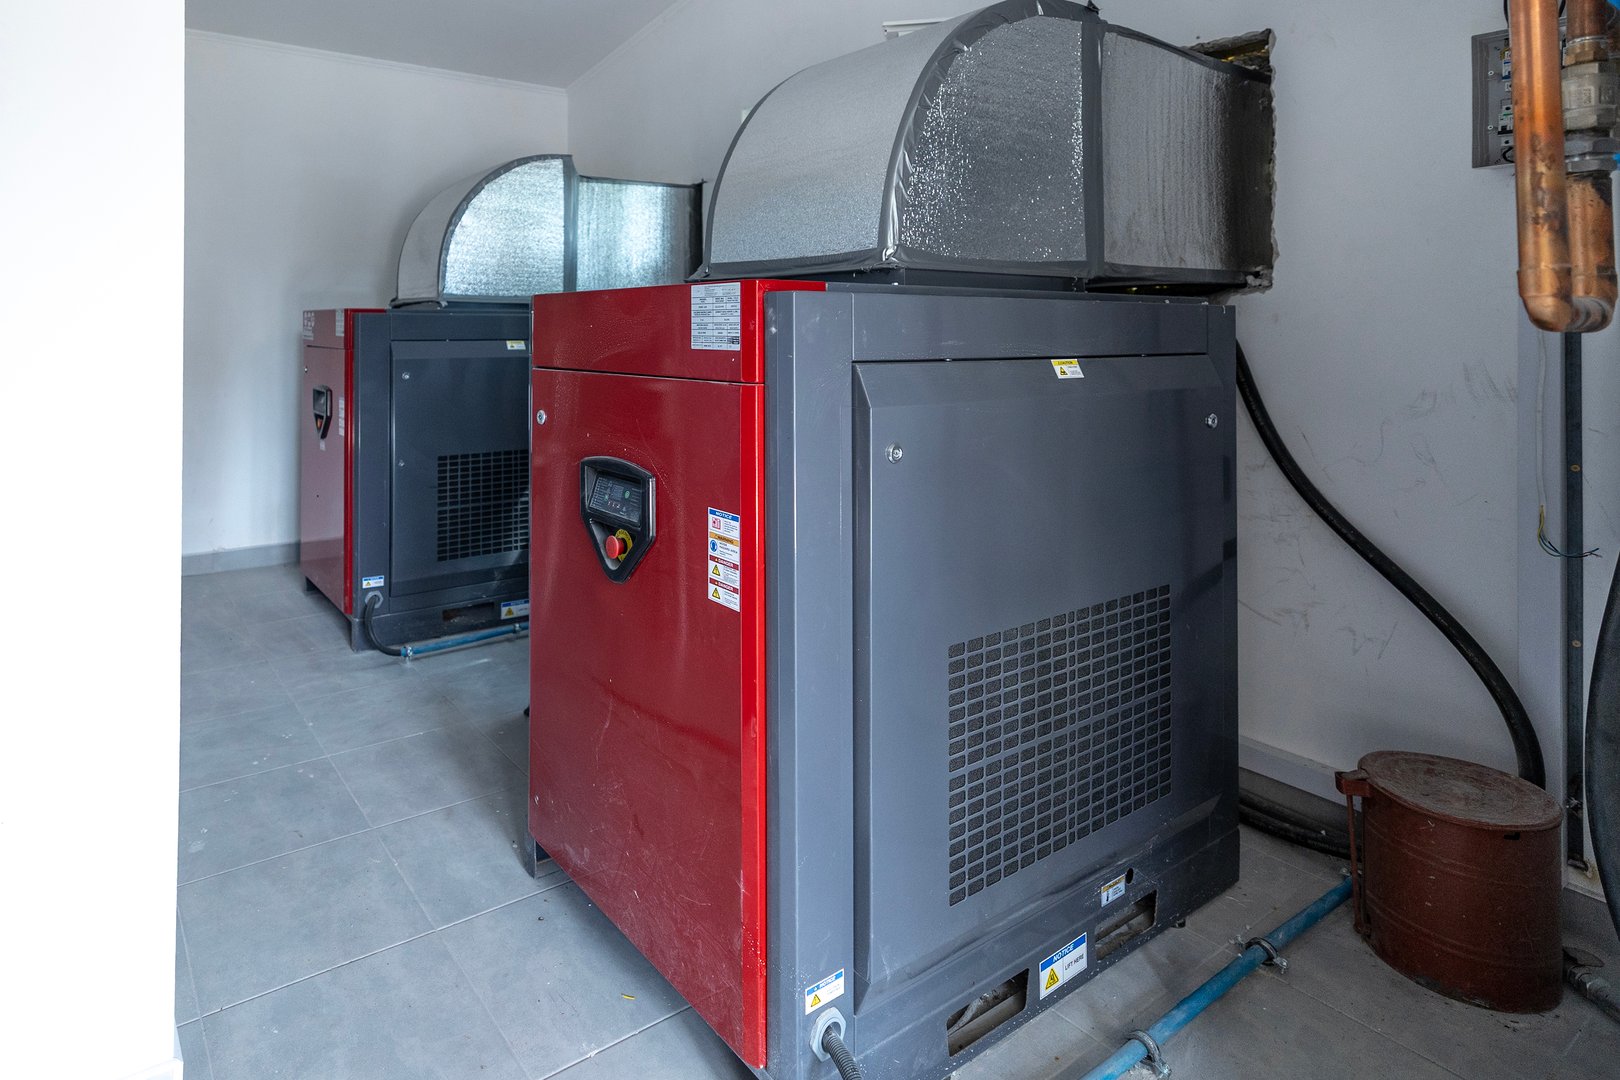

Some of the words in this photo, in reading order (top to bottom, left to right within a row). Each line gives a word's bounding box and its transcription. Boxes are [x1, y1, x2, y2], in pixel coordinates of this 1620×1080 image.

[715, 511, 733, 520] NOTICE
[718, 558, 734, 568] DANGER
[718, 581, 734, 592] DANGER
[1052, 943, 1075, 963] NOTICE
[1064, 960, 1074, 971] LIFT
[1073, 953, 1085, 966] HERE
